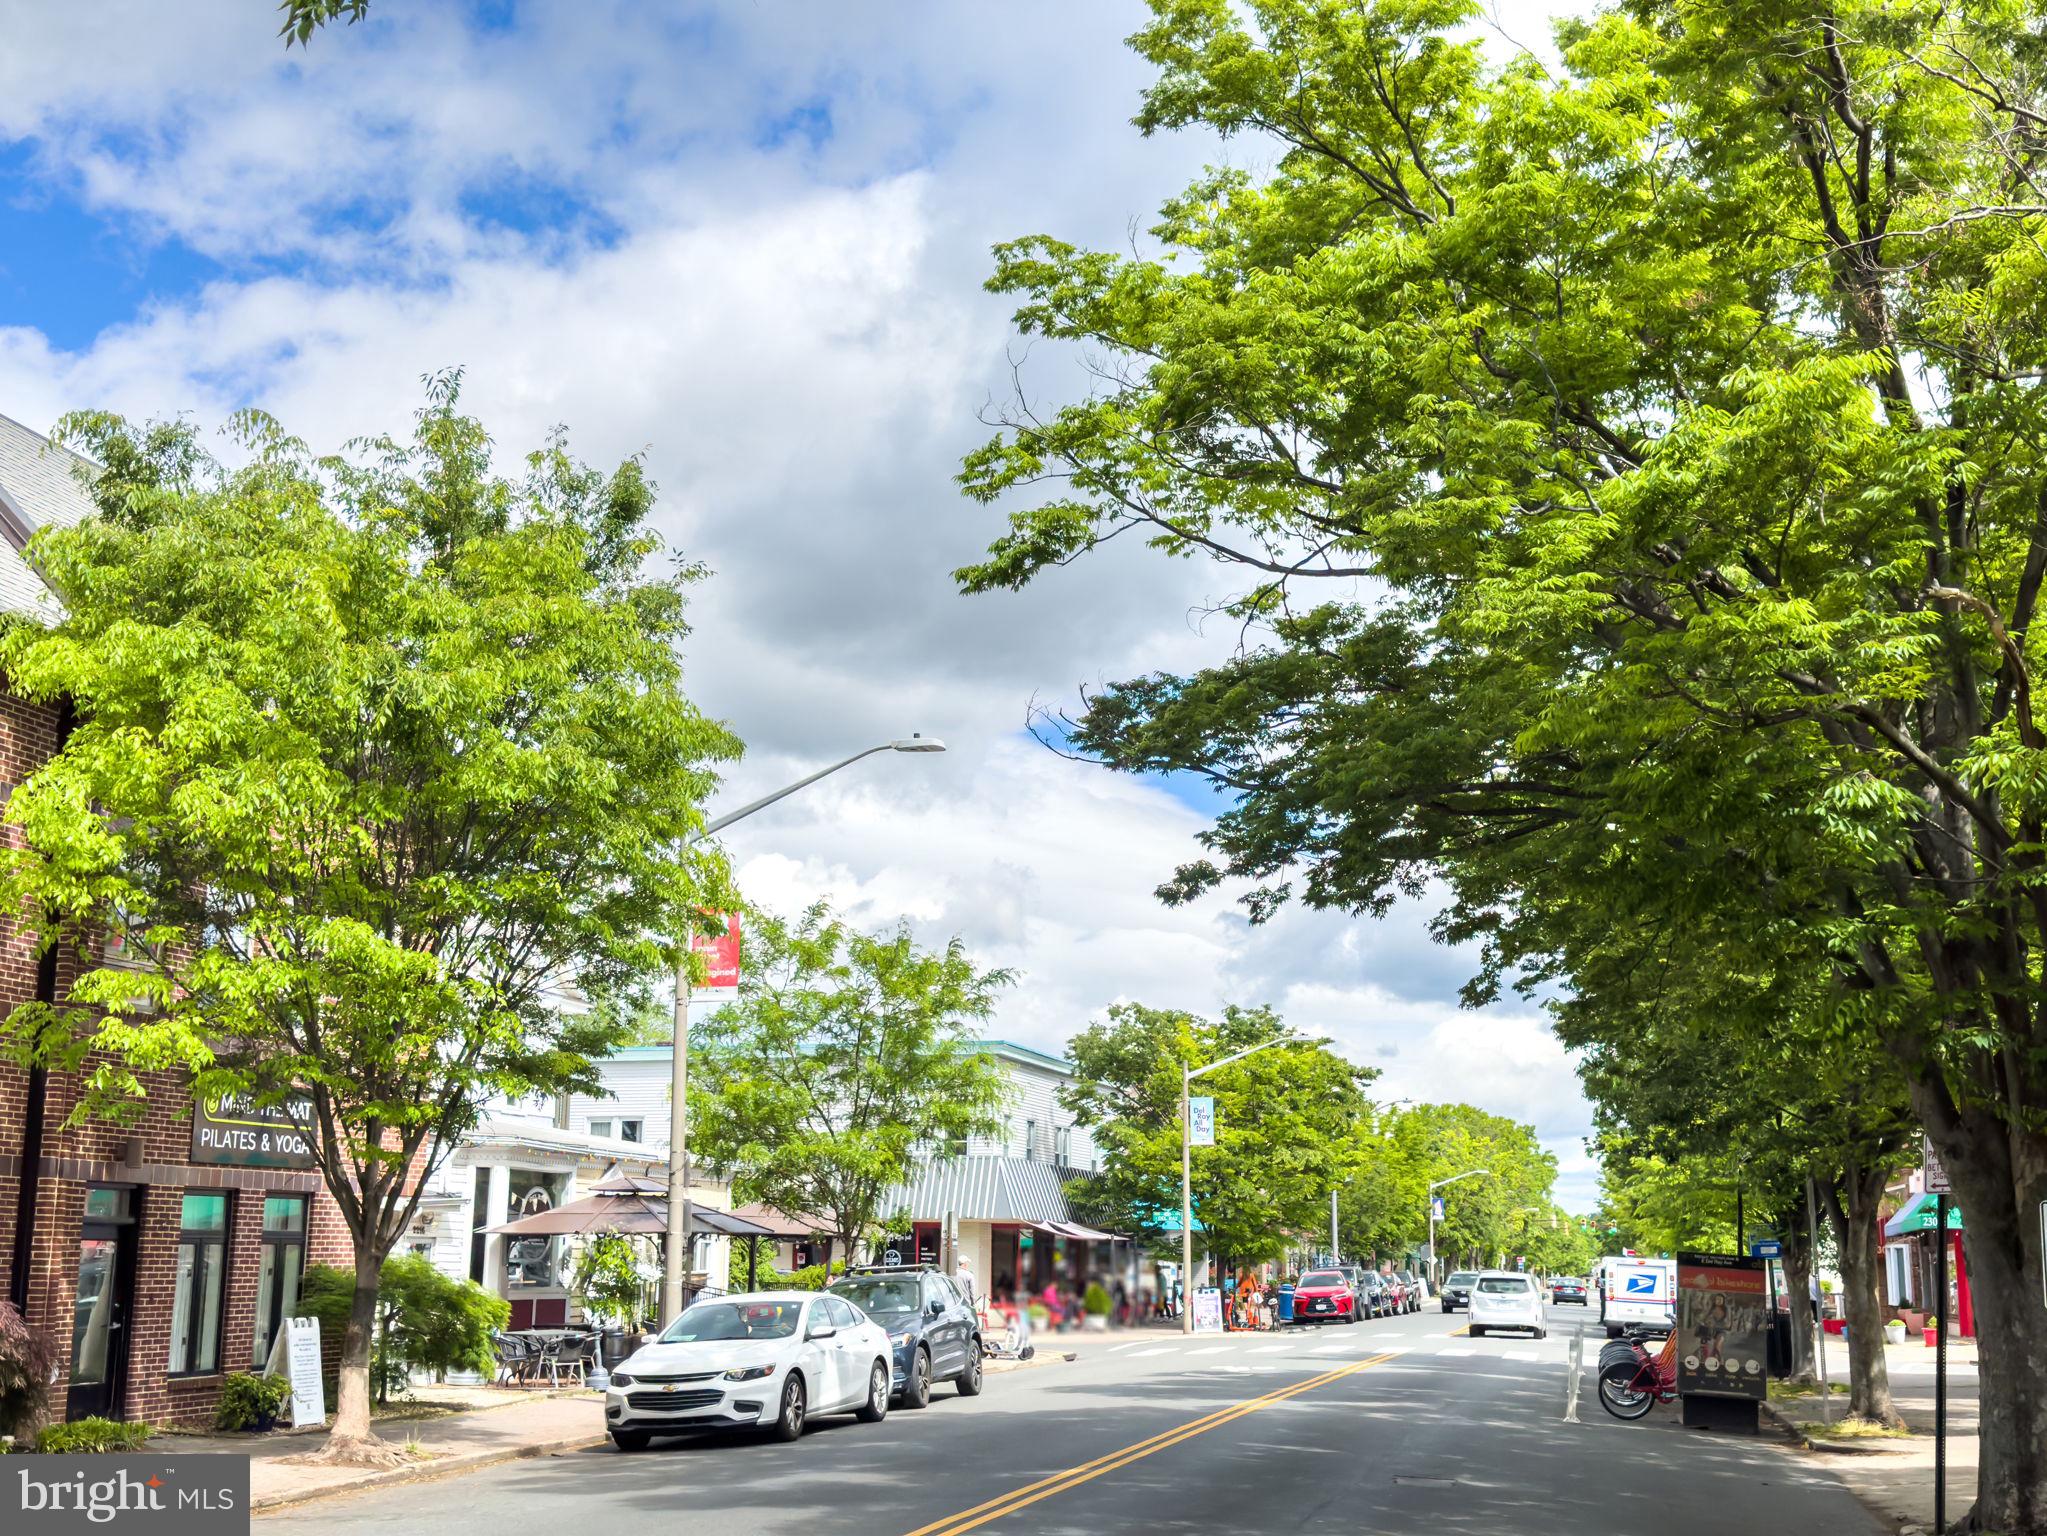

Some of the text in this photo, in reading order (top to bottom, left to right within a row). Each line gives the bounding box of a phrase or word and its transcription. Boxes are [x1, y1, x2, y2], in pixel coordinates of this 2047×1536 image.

[1193, 1106, 1205, 1114] Del
[1197, 1113, 1211, 1121] Ray
[1196, 1125, 1210, 1134] Day
[201, 1128, 310, 1155] PILATES & YOGA
[1923, 1216, 1939, 1227] 230
